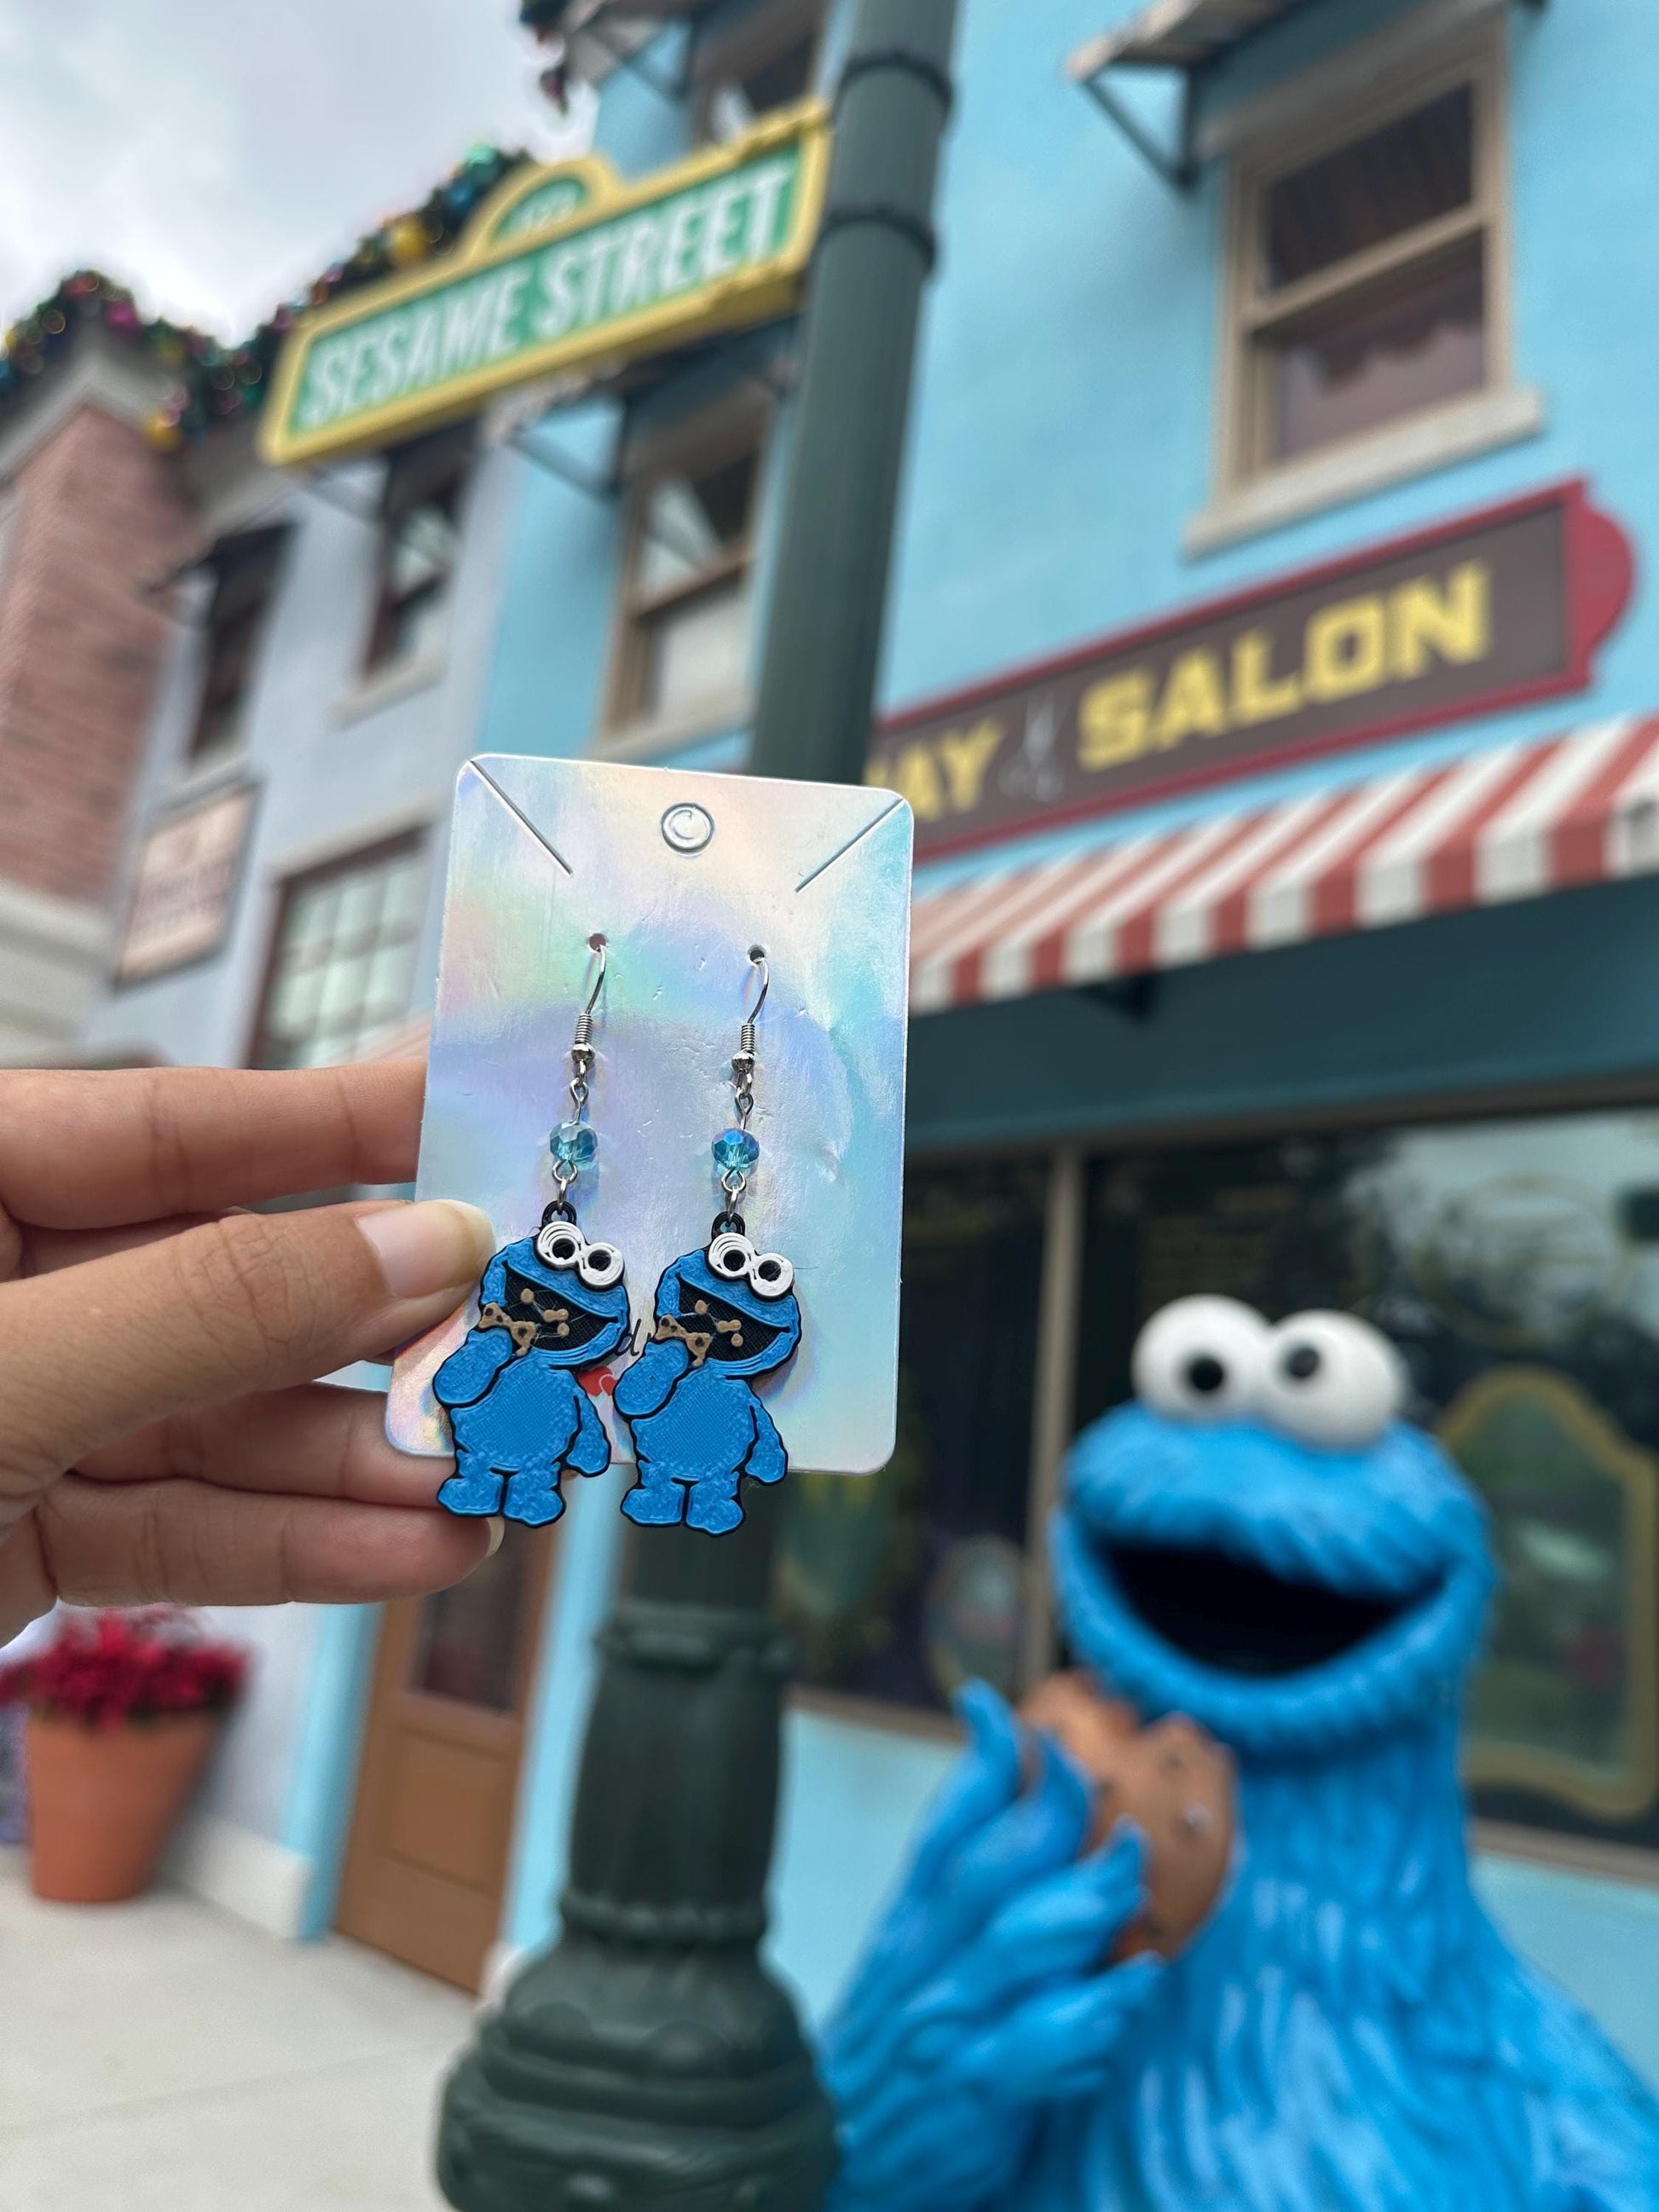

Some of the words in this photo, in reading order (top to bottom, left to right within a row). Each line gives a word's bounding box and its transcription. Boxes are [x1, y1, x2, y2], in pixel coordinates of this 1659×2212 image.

[303, 271, 530, 424] SESAME
[532, 164, 791, 333] STREET
[1078, 560, 1488, 771] SALON
